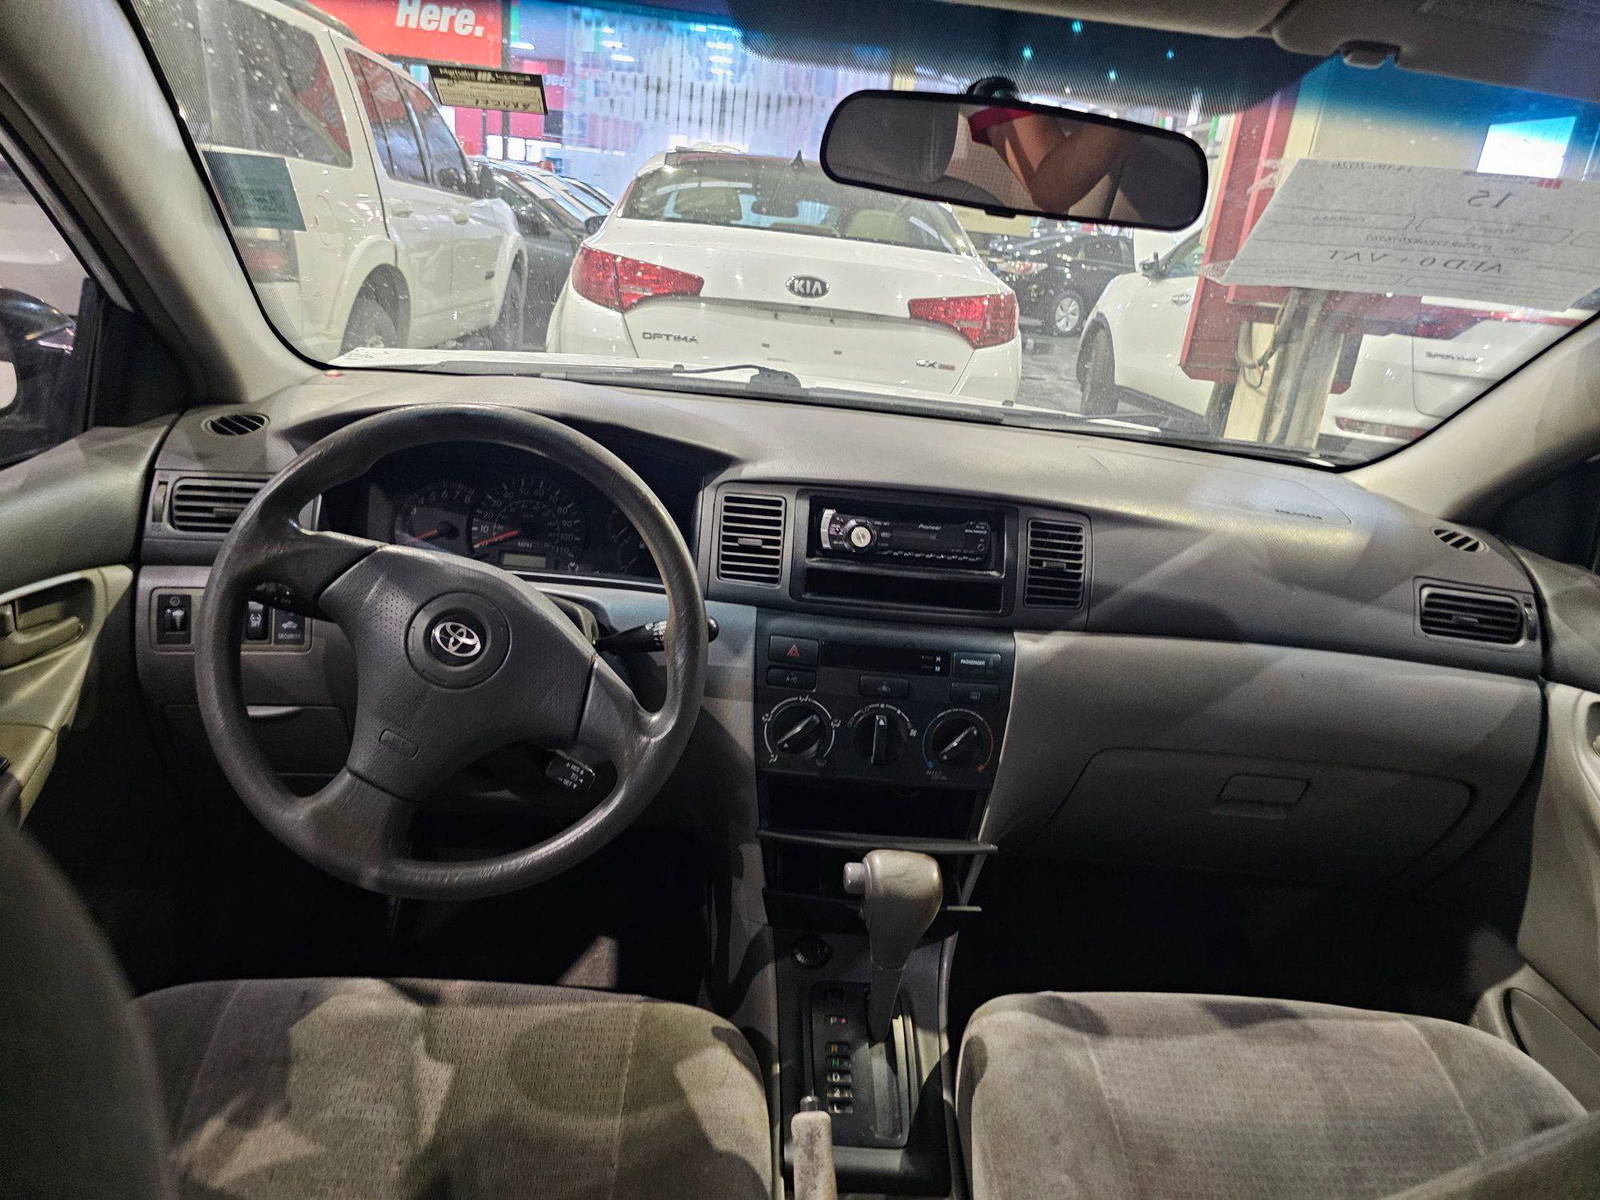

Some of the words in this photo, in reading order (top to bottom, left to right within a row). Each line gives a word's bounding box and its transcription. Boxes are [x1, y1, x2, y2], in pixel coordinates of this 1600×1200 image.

[395, 0, 485, 37] Here.
[794, 279, 823, 296] KIA
[642, 331, 699, 344] OPTIMA
